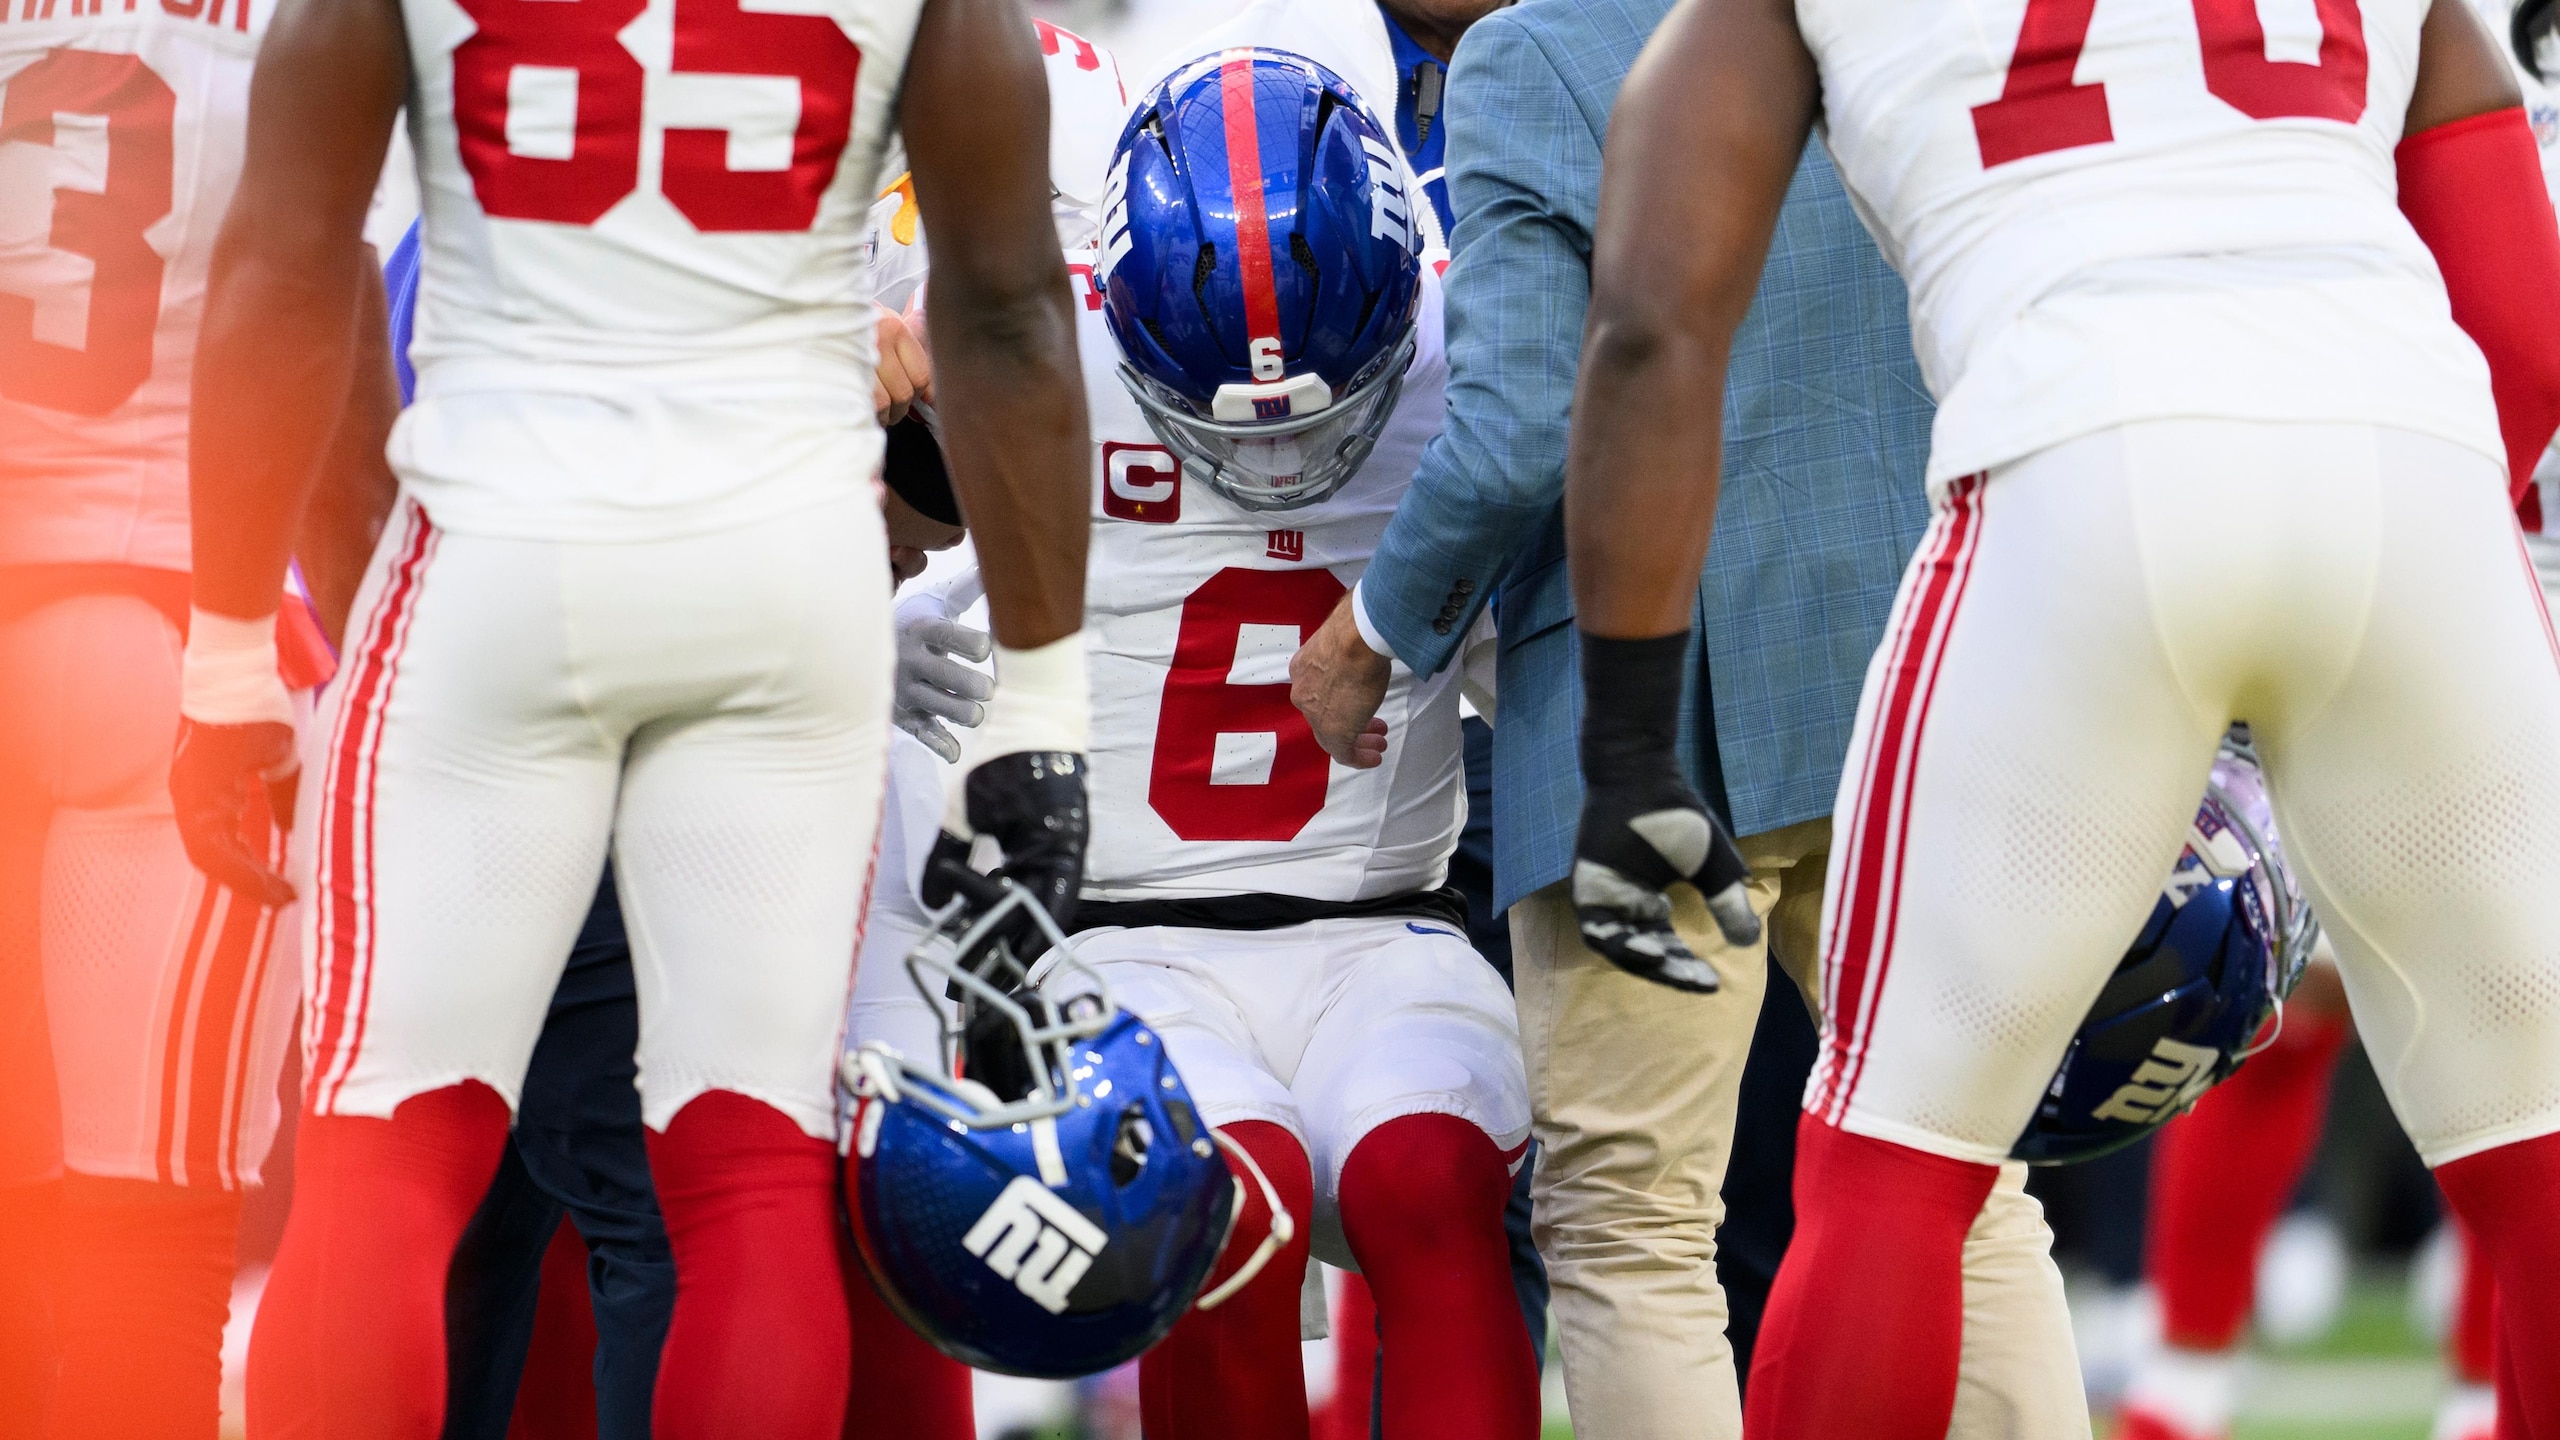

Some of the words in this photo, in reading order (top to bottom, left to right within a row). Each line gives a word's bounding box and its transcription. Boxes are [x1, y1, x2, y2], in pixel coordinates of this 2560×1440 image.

[452, 0, 862, 232] 85
[1249, 336, 1284, 382] 6
[1109, 448, 1176, 502] C
[1148, 567, 1348, 841] 6
